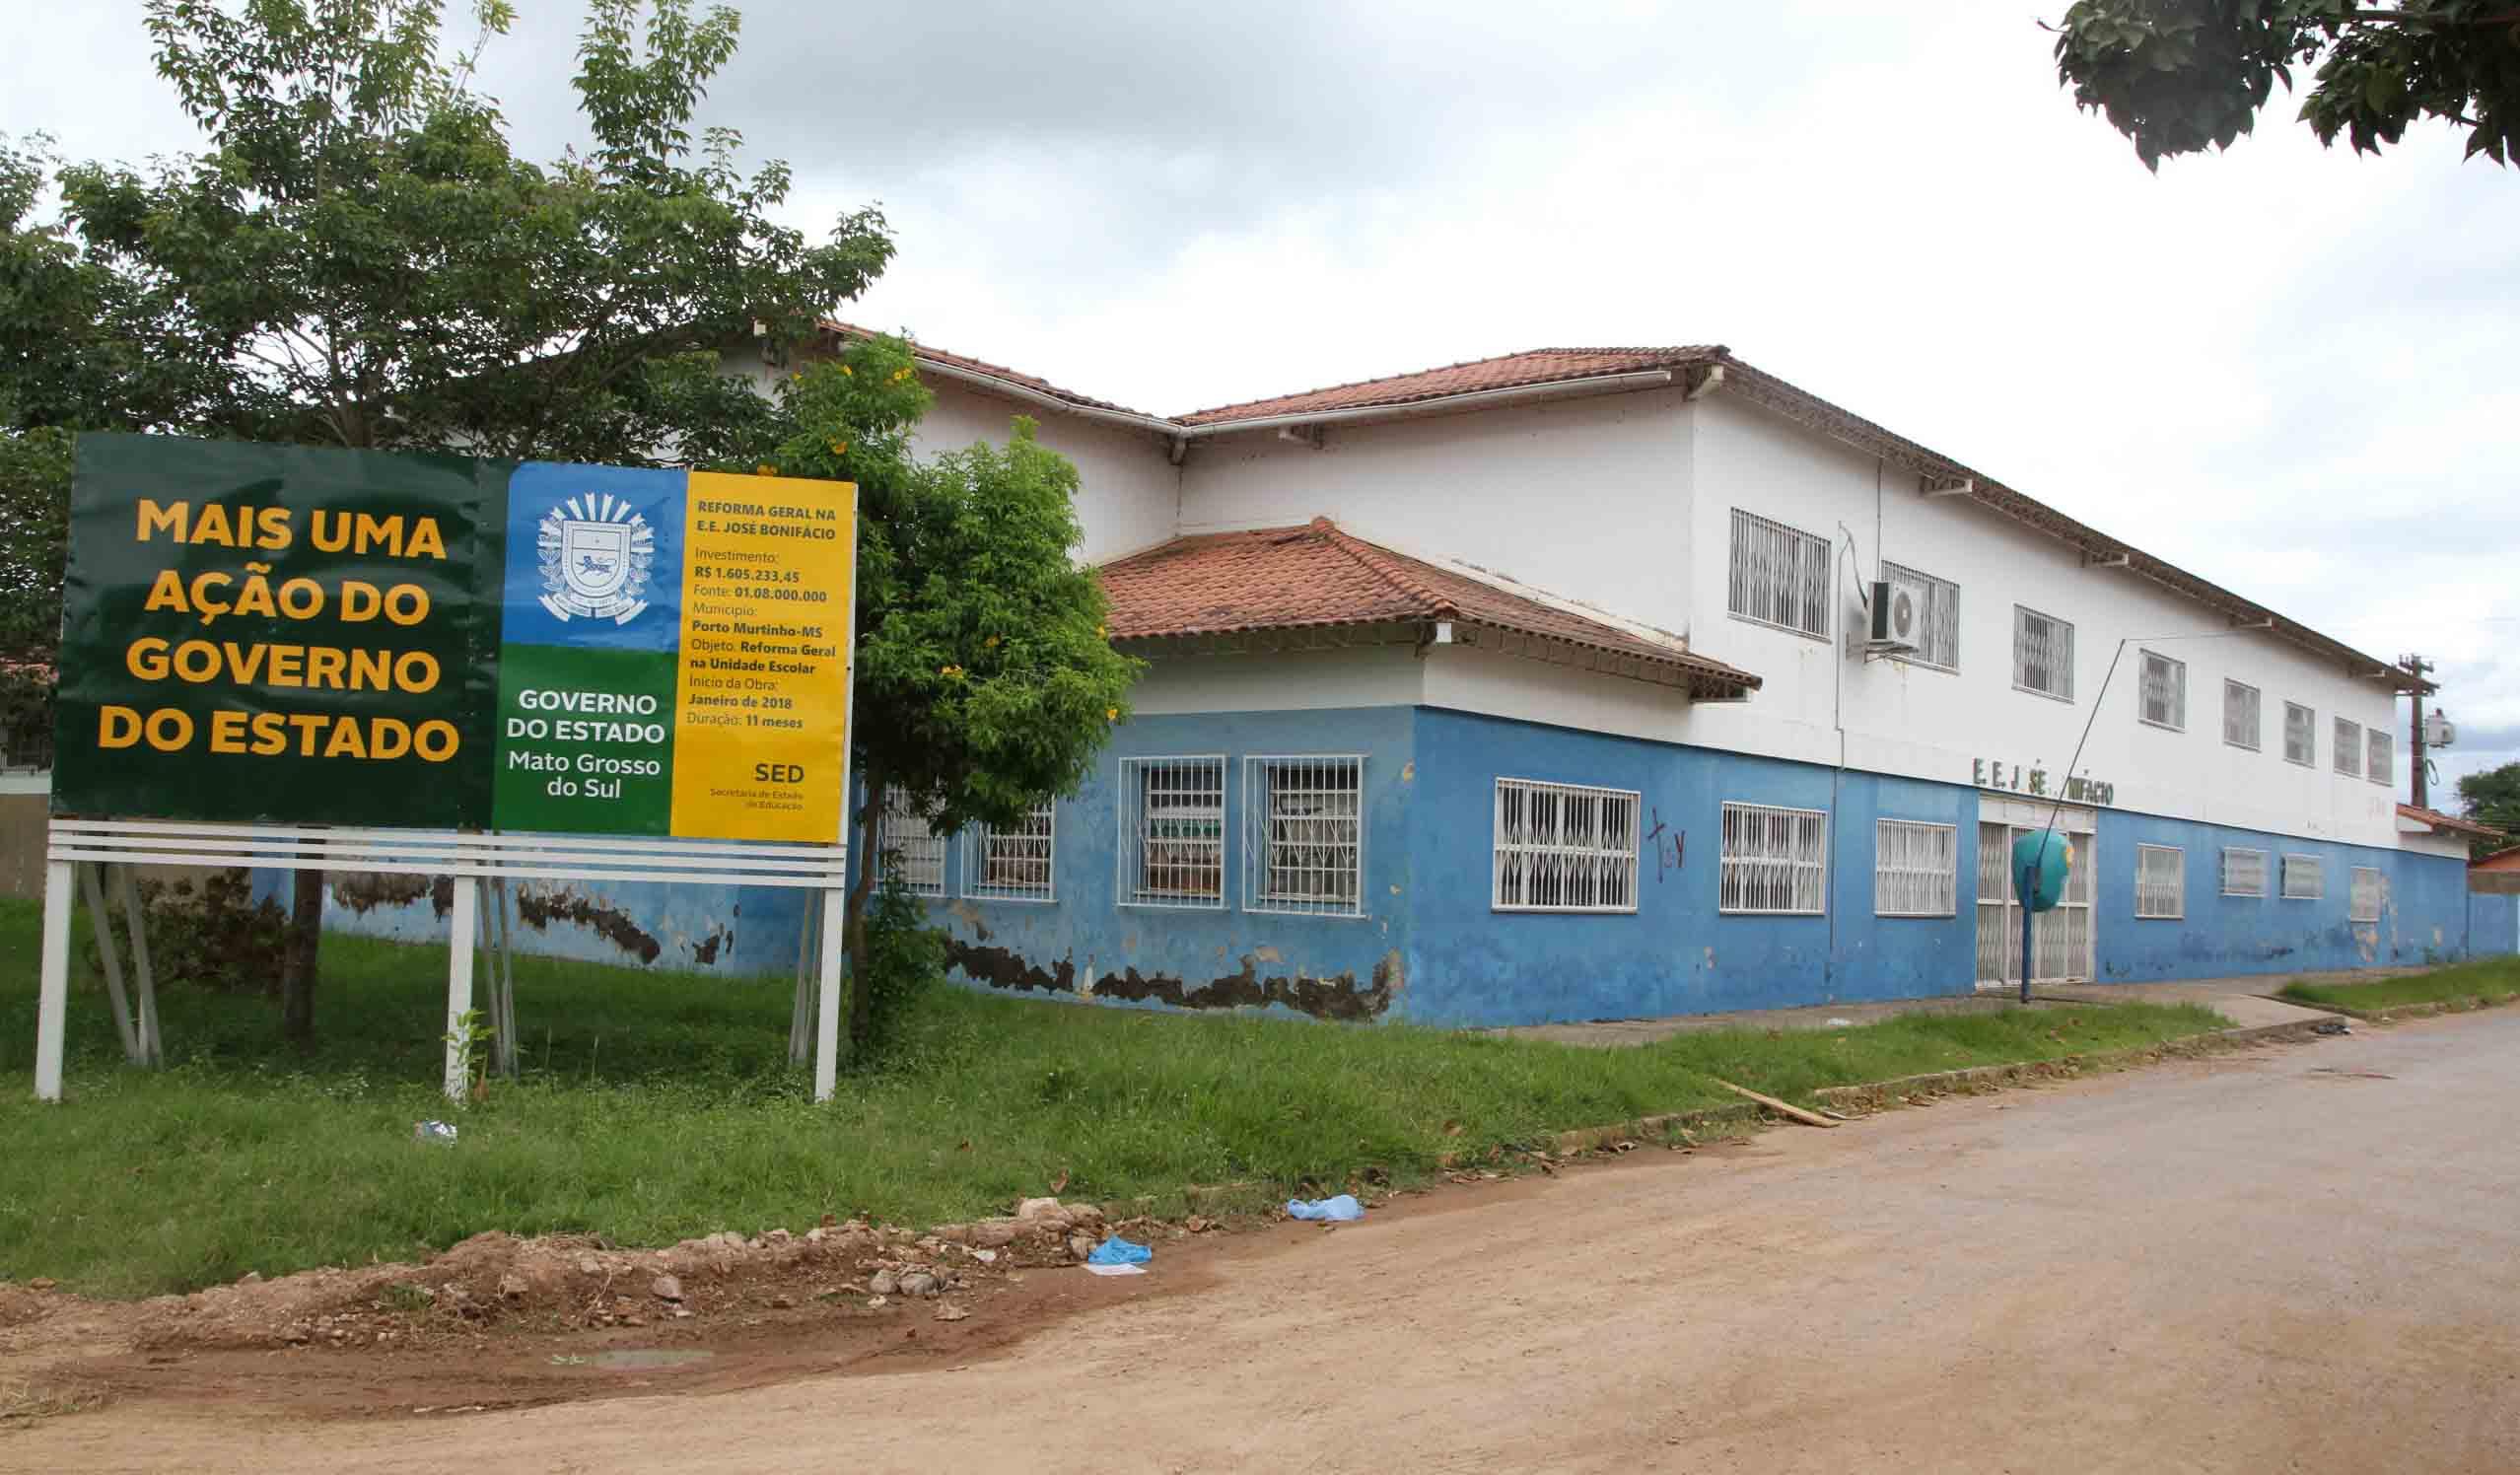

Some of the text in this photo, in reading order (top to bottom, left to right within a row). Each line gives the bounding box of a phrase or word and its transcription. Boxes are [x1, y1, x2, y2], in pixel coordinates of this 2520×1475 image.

[697, 501, 836, 521] REFORMA GERAL NA
[135, 496, 447, 559] MAIS UMA
[696, 520, 721, 532] E.E.
[723, 520, 757, 535] JOSÉ
[695, 546, 780, 564] Investimento:
[694, 566, 712, 579] R$
[144, 561, 431, 626] AÇÃO DO
[691, 619, 823, 639] Porto Murtinho-MS
[740, 641, 798, 656] Reforma
[801, 644, 837, 658] Geral
[126, 637, 441, 694] GOVERNO
[690, 658, 816, 674] na Unidade Escolar
[726, 677, 741, 689] da
[518, 689, 658, 716] GOVERNO
[687, 693, 793, 710] Janeiro de 2018
[686, 711, 804, 730] Duração: 11 meses
[99, 704, 459, 763] DO ESTADO
[506, 718, 665, 744] DO ESTADO
[508, 750, 661, 776] Mato Grosso
[754, 763, 805, 784] SED
[546, 776, 622, 800] do Sul
